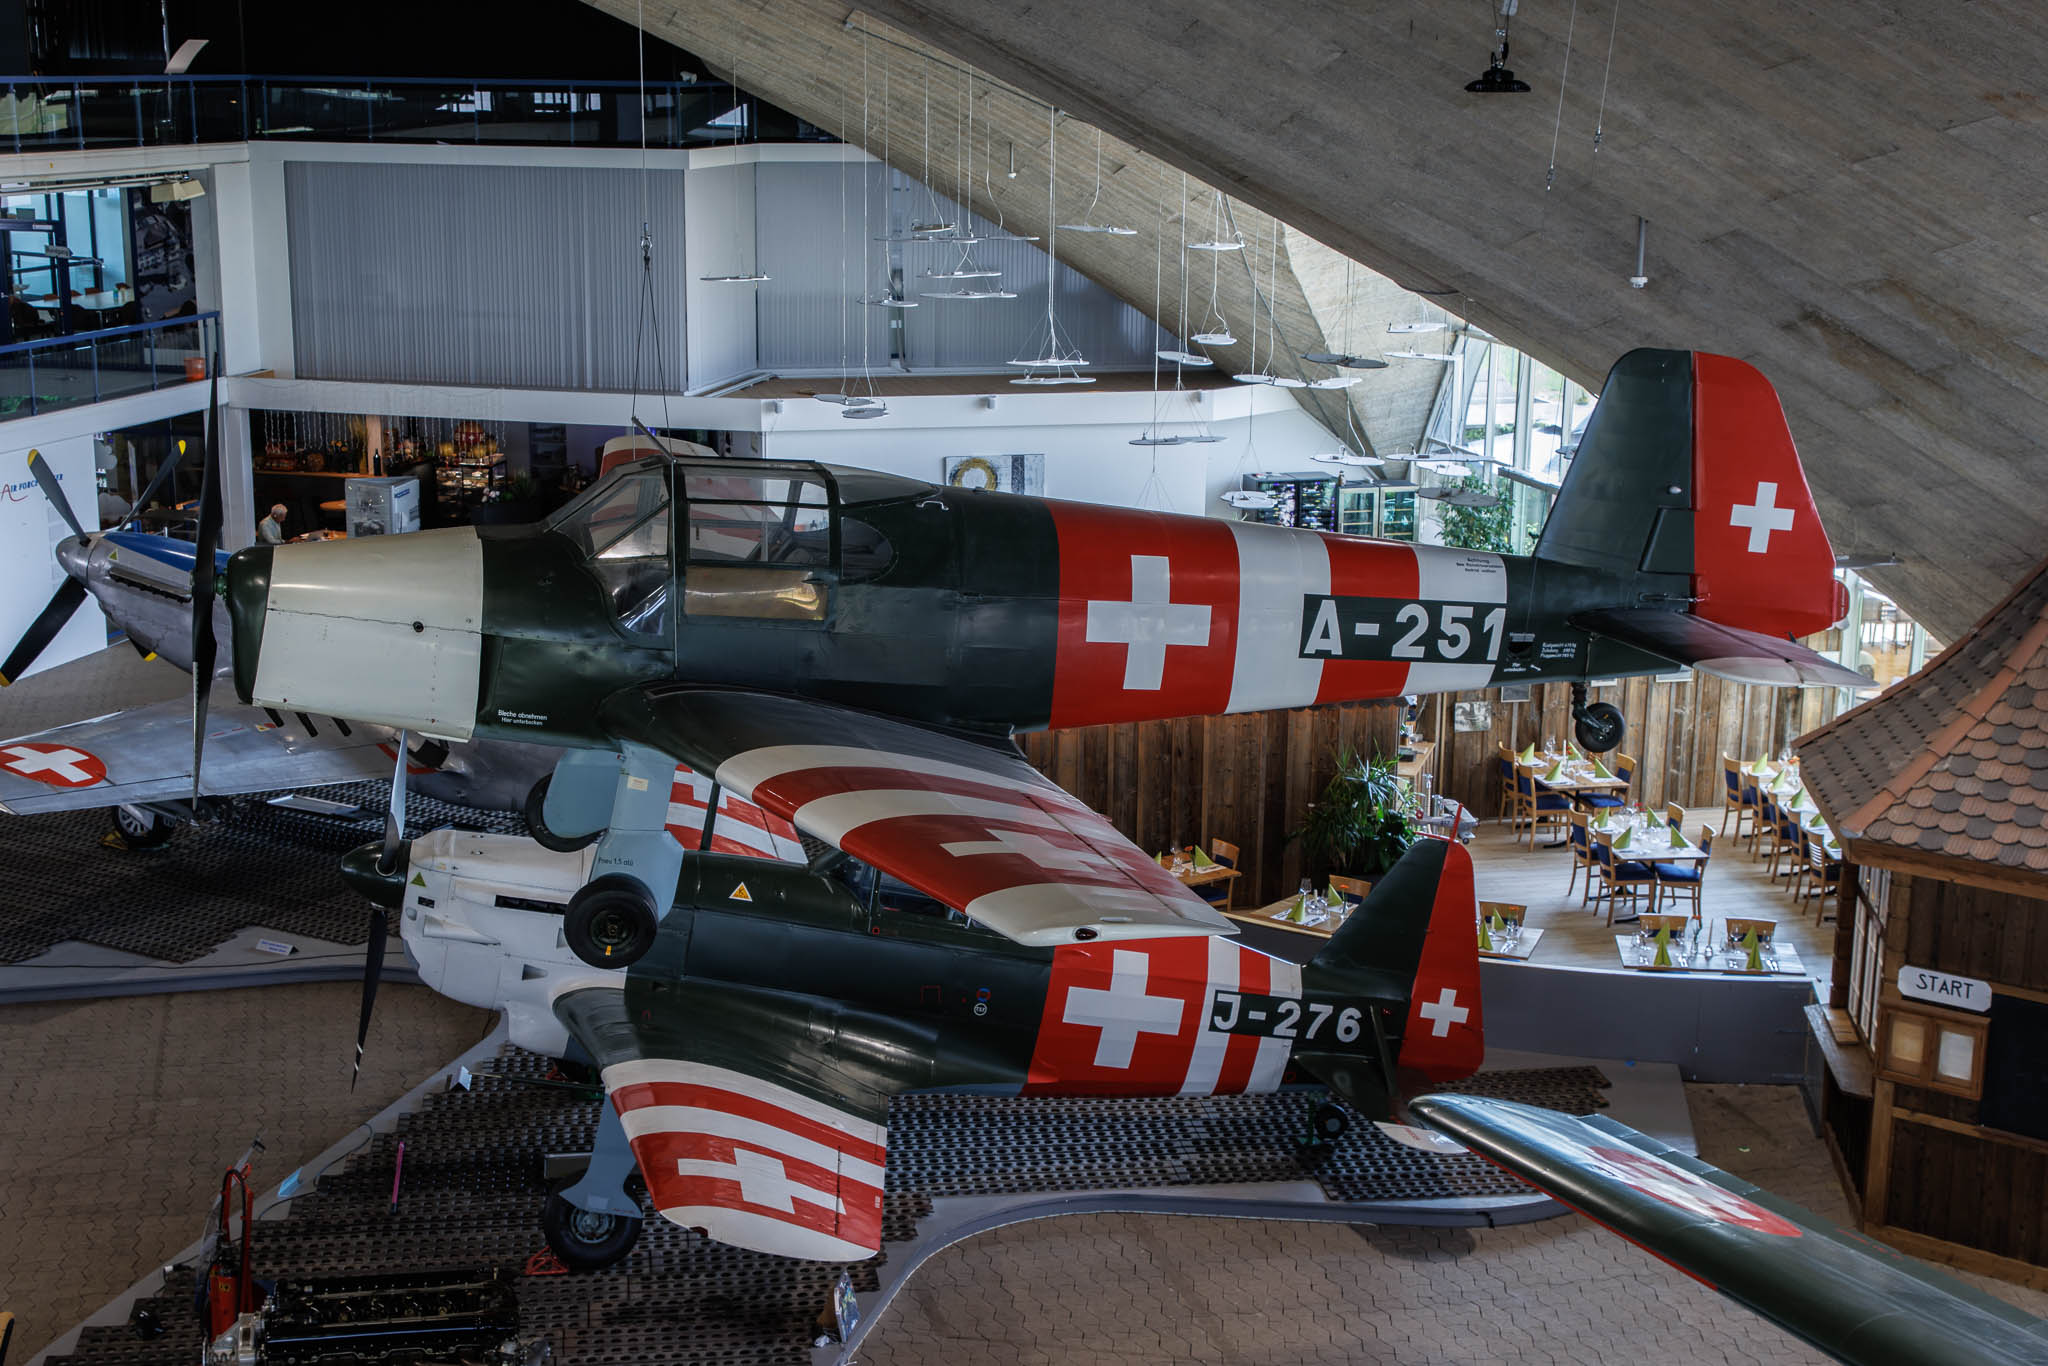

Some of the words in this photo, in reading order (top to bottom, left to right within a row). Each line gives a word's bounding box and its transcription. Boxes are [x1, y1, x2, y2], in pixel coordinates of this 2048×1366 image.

[1304, 600, 1506, 660] A-251
[498, 709, 516, 717] Bleche
[1916, 973, 1974, 999] START
[1213, 993, 1362, 1043] J-276
